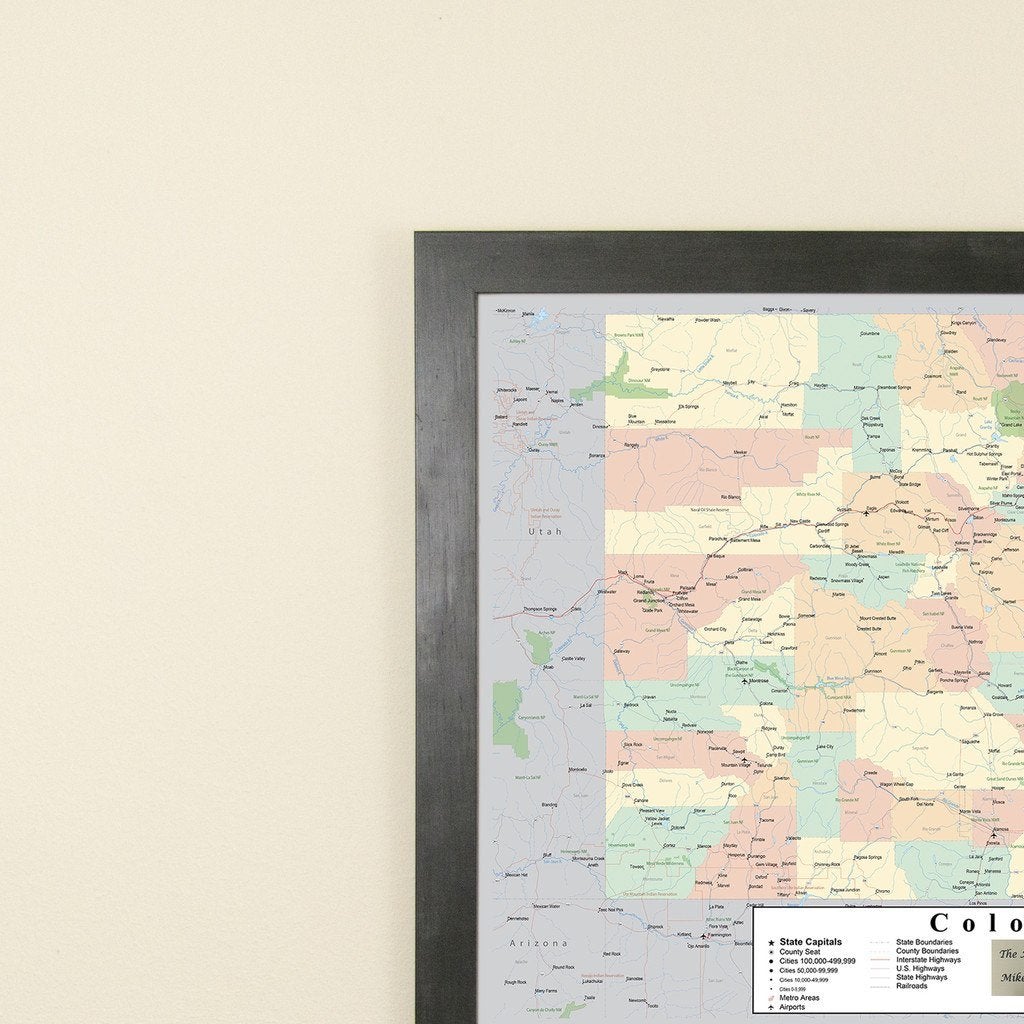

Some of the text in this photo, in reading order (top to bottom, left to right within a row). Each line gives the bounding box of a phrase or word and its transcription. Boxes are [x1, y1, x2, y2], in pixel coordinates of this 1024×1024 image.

[780, 938, 842, 947] State Capitals
[999, 949, 1018, 959] The
[913, 965, 945, 973] Highways
